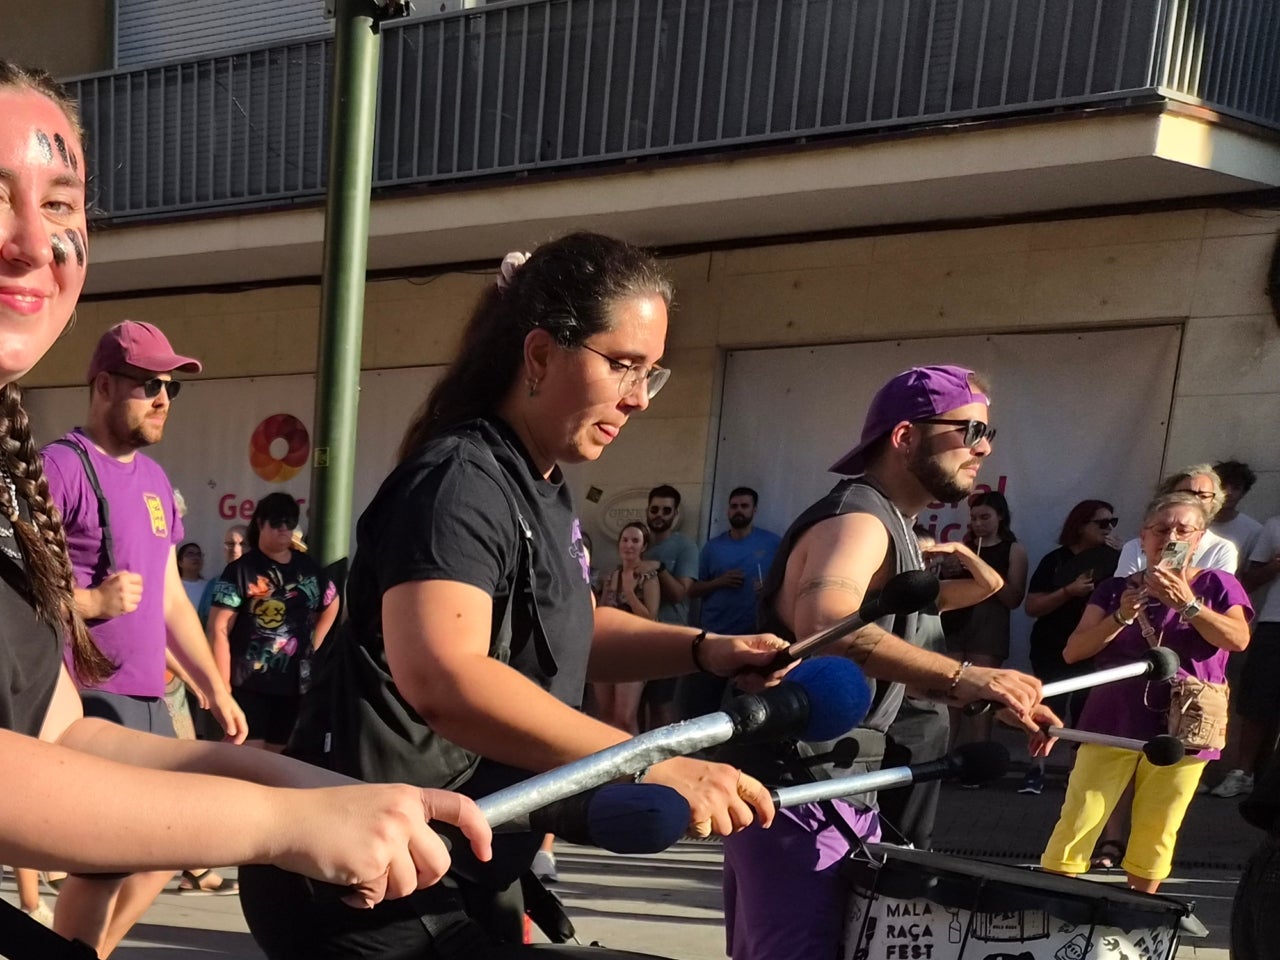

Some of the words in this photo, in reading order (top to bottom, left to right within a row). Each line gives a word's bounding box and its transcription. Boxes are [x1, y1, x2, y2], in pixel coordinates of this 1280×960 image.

[886, 904, 933, 917] MALA
[886, 924, 933, 942] RAÇA
[886, 944, 934, 960] FEST
